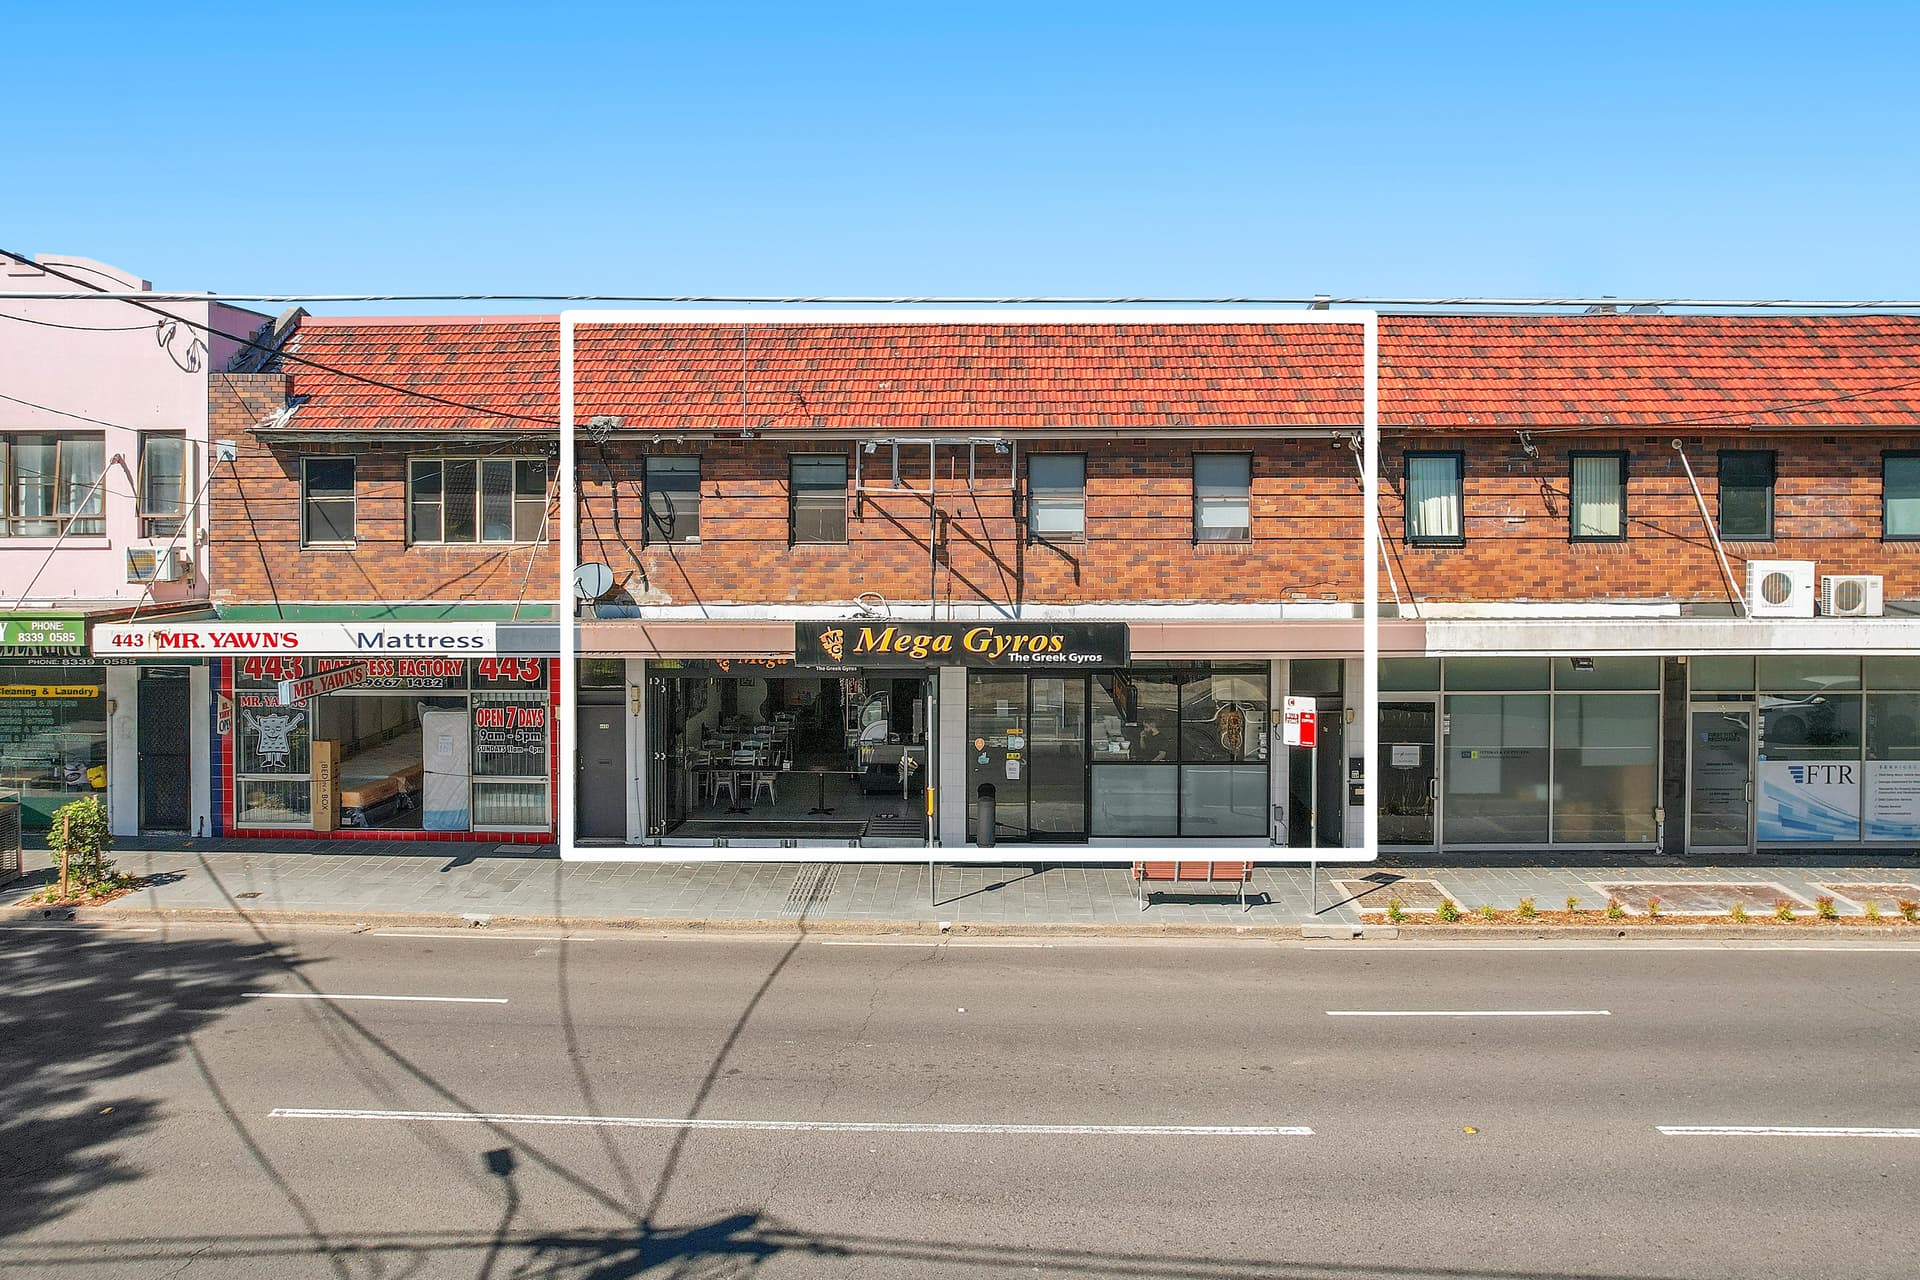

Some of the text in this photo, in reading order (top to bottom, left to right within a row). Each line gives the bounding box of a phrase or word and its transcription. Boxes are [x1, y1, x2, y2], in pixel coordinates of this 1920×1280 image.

[31, 621, 64, 630] PHONE:
[18, 632, 76, 642] 8339 0585
[112, 634, 144, 647] 443
[159, 632, 299, 649] MR. YAWN'S
[357, 632, 484, 649] Mattress
[852, 627, 1065, 660] Mega Gyros
[1008, 653, 1103, 664] The Greek Gyros
[244, 656, 304, 681] 443
[399, 658, 465, 677] FACTORY
[479, 656, 541, 682] 443
[293, 667, 364, 699] MR. YAWN'S
[407, 677, 444, 688] 1482
[42, 687, 49, 695] &
[55, 687, 94, 696] Laundry
[240, 695, 263, 707] MR.
[476, 706, 544, 728] OPEN 7 DAYS
[479, 729, 505, 741] 9am
[515, 729, 542, 743] 5pm
[1806, 764, 1855, 785] FTR
